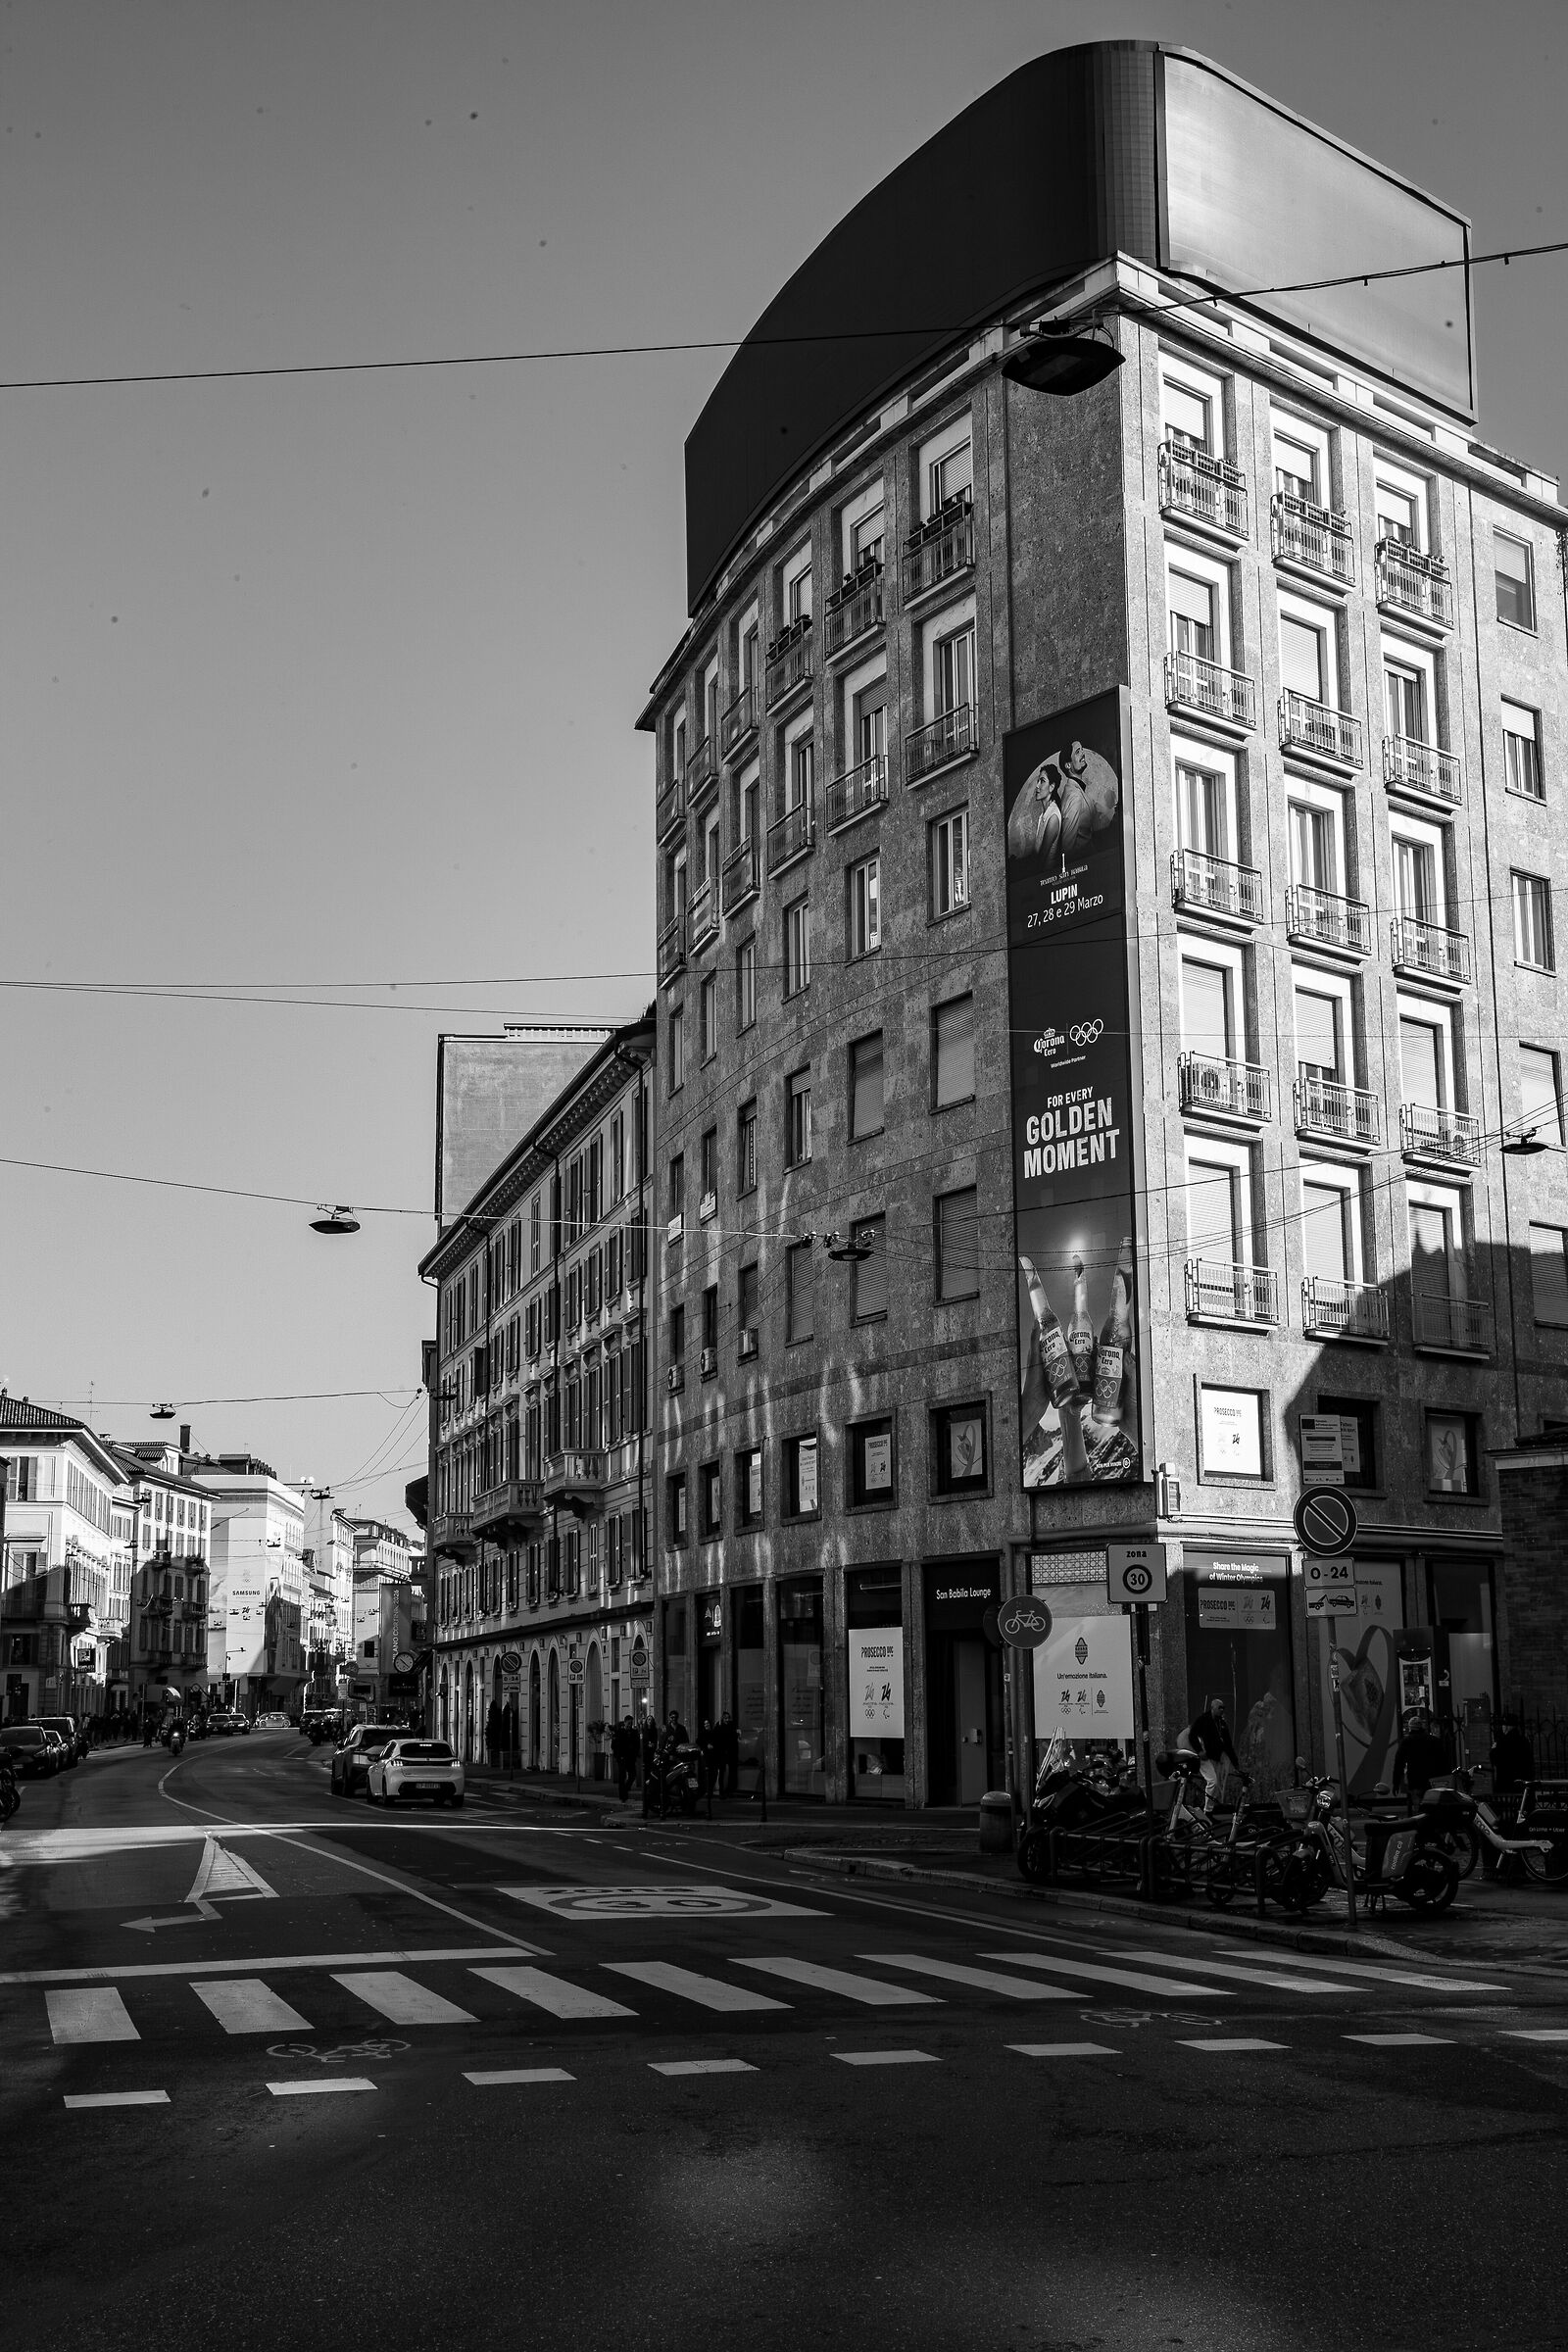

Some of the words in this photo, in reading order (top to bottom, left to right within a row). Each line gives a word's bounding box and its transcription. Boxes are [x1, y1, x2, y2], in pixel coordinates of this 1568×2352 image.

[1051, 884, 1078, 905] LUPIN
[1028, 913, 1041, 927] 27,
[1043, 907, 1054, 922] 28
[1056, 908, 1061, 917] e
[1064, 902, 1075, 915] 29
[1078, 895, 1102, 911] Marzo
[1034, 1036, 1065, 1053] Corona
[1044, 1048, 1056, 1056] Cero
[1048, 1095, 1063, 1108] FOR
[1065, 1086, 1093, 1103] EVERY
[1026, 1098, 1112, 1145] GOLDEN
[1024, 1129, 1119, 1178] MOMENT
[1213, 1562, 1230, 1571] Share
[1231, 1562, 1241, 1571] the
[1242, 1563, 1258, 1574] Magic
[1331, 1567, 1348, 1579] 24
[1130, 1574, 1145, 1586] 30
[1216, 1572, 1236, 1581] Winter
[1237, 1574, 1263, 1584] Olympics
[936, 1589, 948, 1599] San
[949, 1588, 968, 1598] Babila
[970, 1588, 991, 1598] Lounge
[1200, 1599, 1227, 1610] PROSECCO
[861, 1646, 886, 1657] PROSECCO
[597, 1899, 721, 1908] 30
